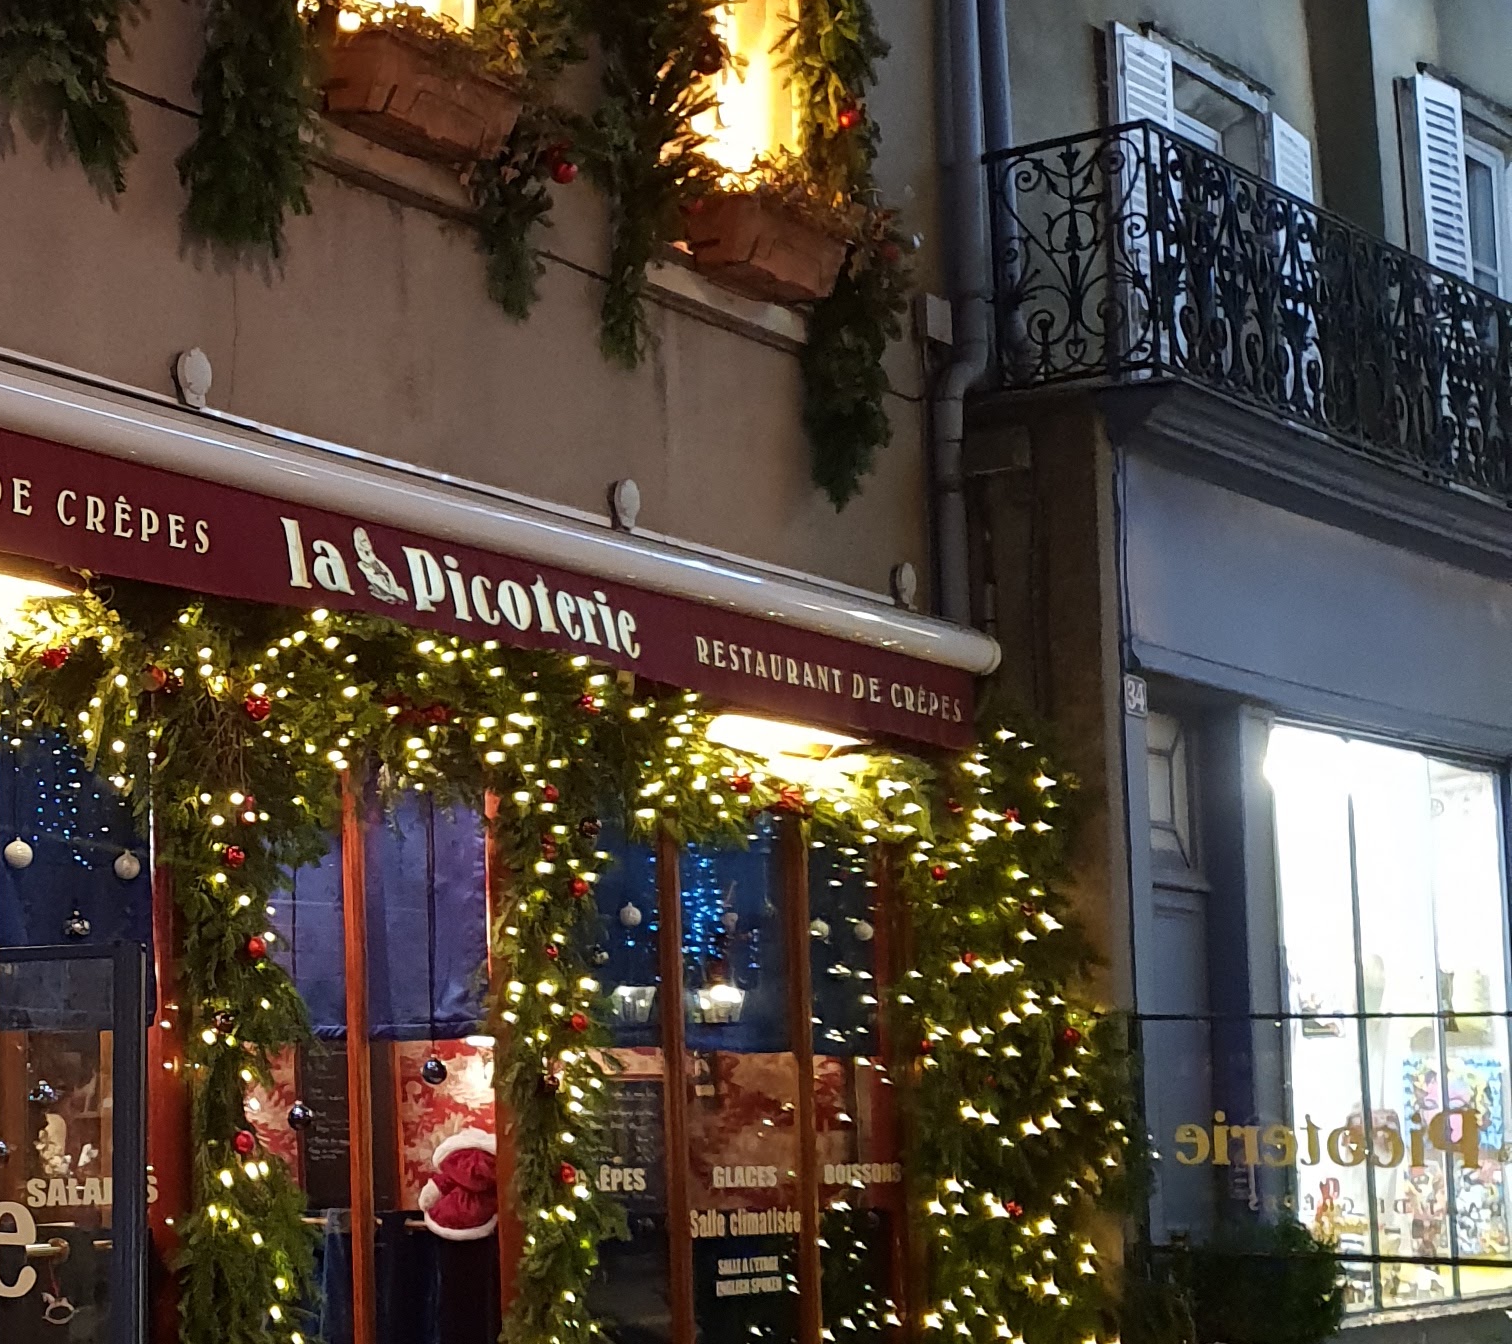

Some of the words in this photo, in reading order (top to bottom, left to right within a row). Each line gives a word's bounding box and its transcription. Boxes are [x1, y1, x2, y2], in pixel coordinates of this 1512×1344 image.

[56, 490, 210, 555] CRÊPES
[279, 516, 356, 596] la
[401, 545, 642, 659] Picoterie
[695, 634, 843, 696] RESTAURANT
[850, 673, 882, 704] DE
[890, 681, 964, 724] CRÊPES
[1128, 679, 1145, 712] 34
[574, 1164, 647, 1192] CÊPES
[712, 1164, 778, 1189] GLACES
[823, 1161, 903, 1185] BOISSONS
[26, 1176, 159, 1208] SALAS
[690, 1208, 726, 1239] Salle
[729, 1204, 802, 1237] climatisée
